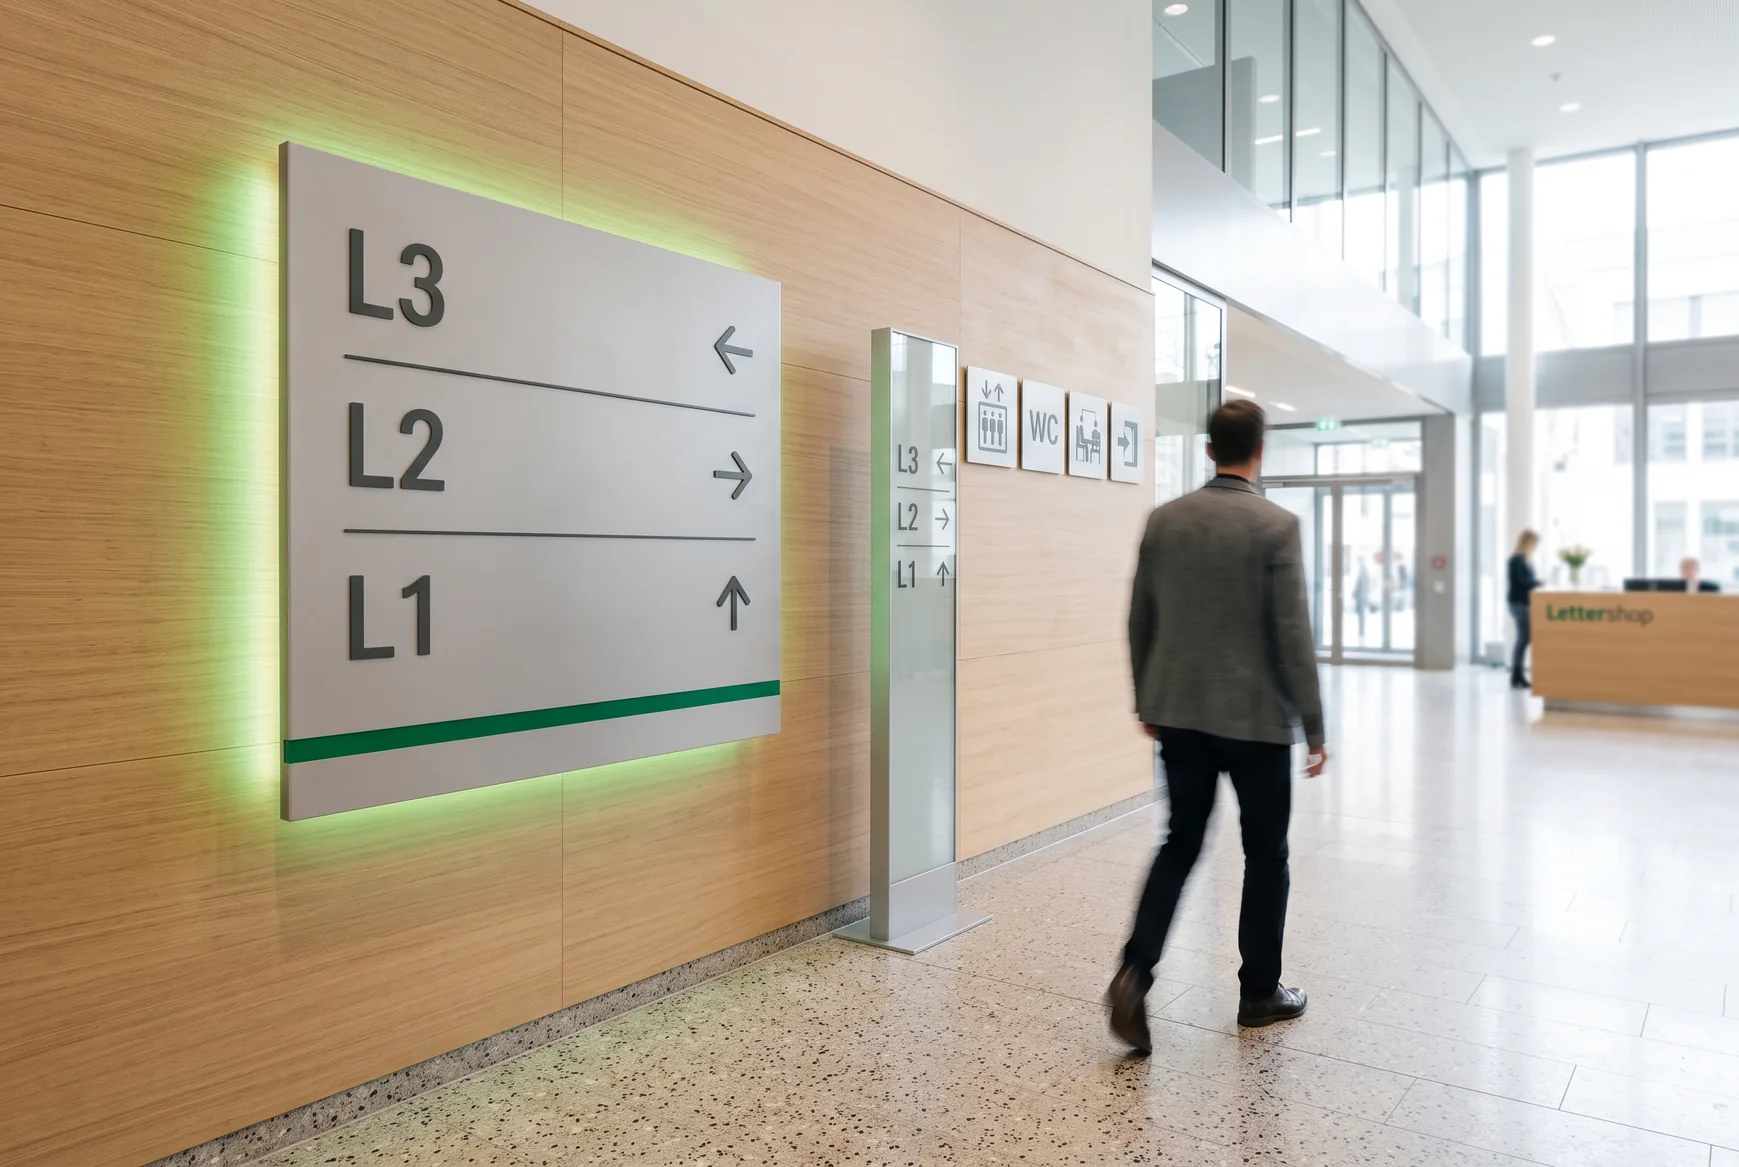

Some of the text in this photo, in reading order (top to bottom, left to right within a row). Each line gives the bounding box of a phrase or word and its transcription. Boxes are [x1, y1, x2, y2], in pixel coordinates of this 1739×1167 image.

[348, 227, 446, 328] L3
[1029, 409, 1059, 445] WC
[348, 402, 446, 492] L2
[897, 443, 919, 475] L3
[897, 502, 919, 531] L2
[897, 560, 916, 588] L1
[348, 574, 432, 661] L1
[1546, 604, 1654, 628] Lettershop
